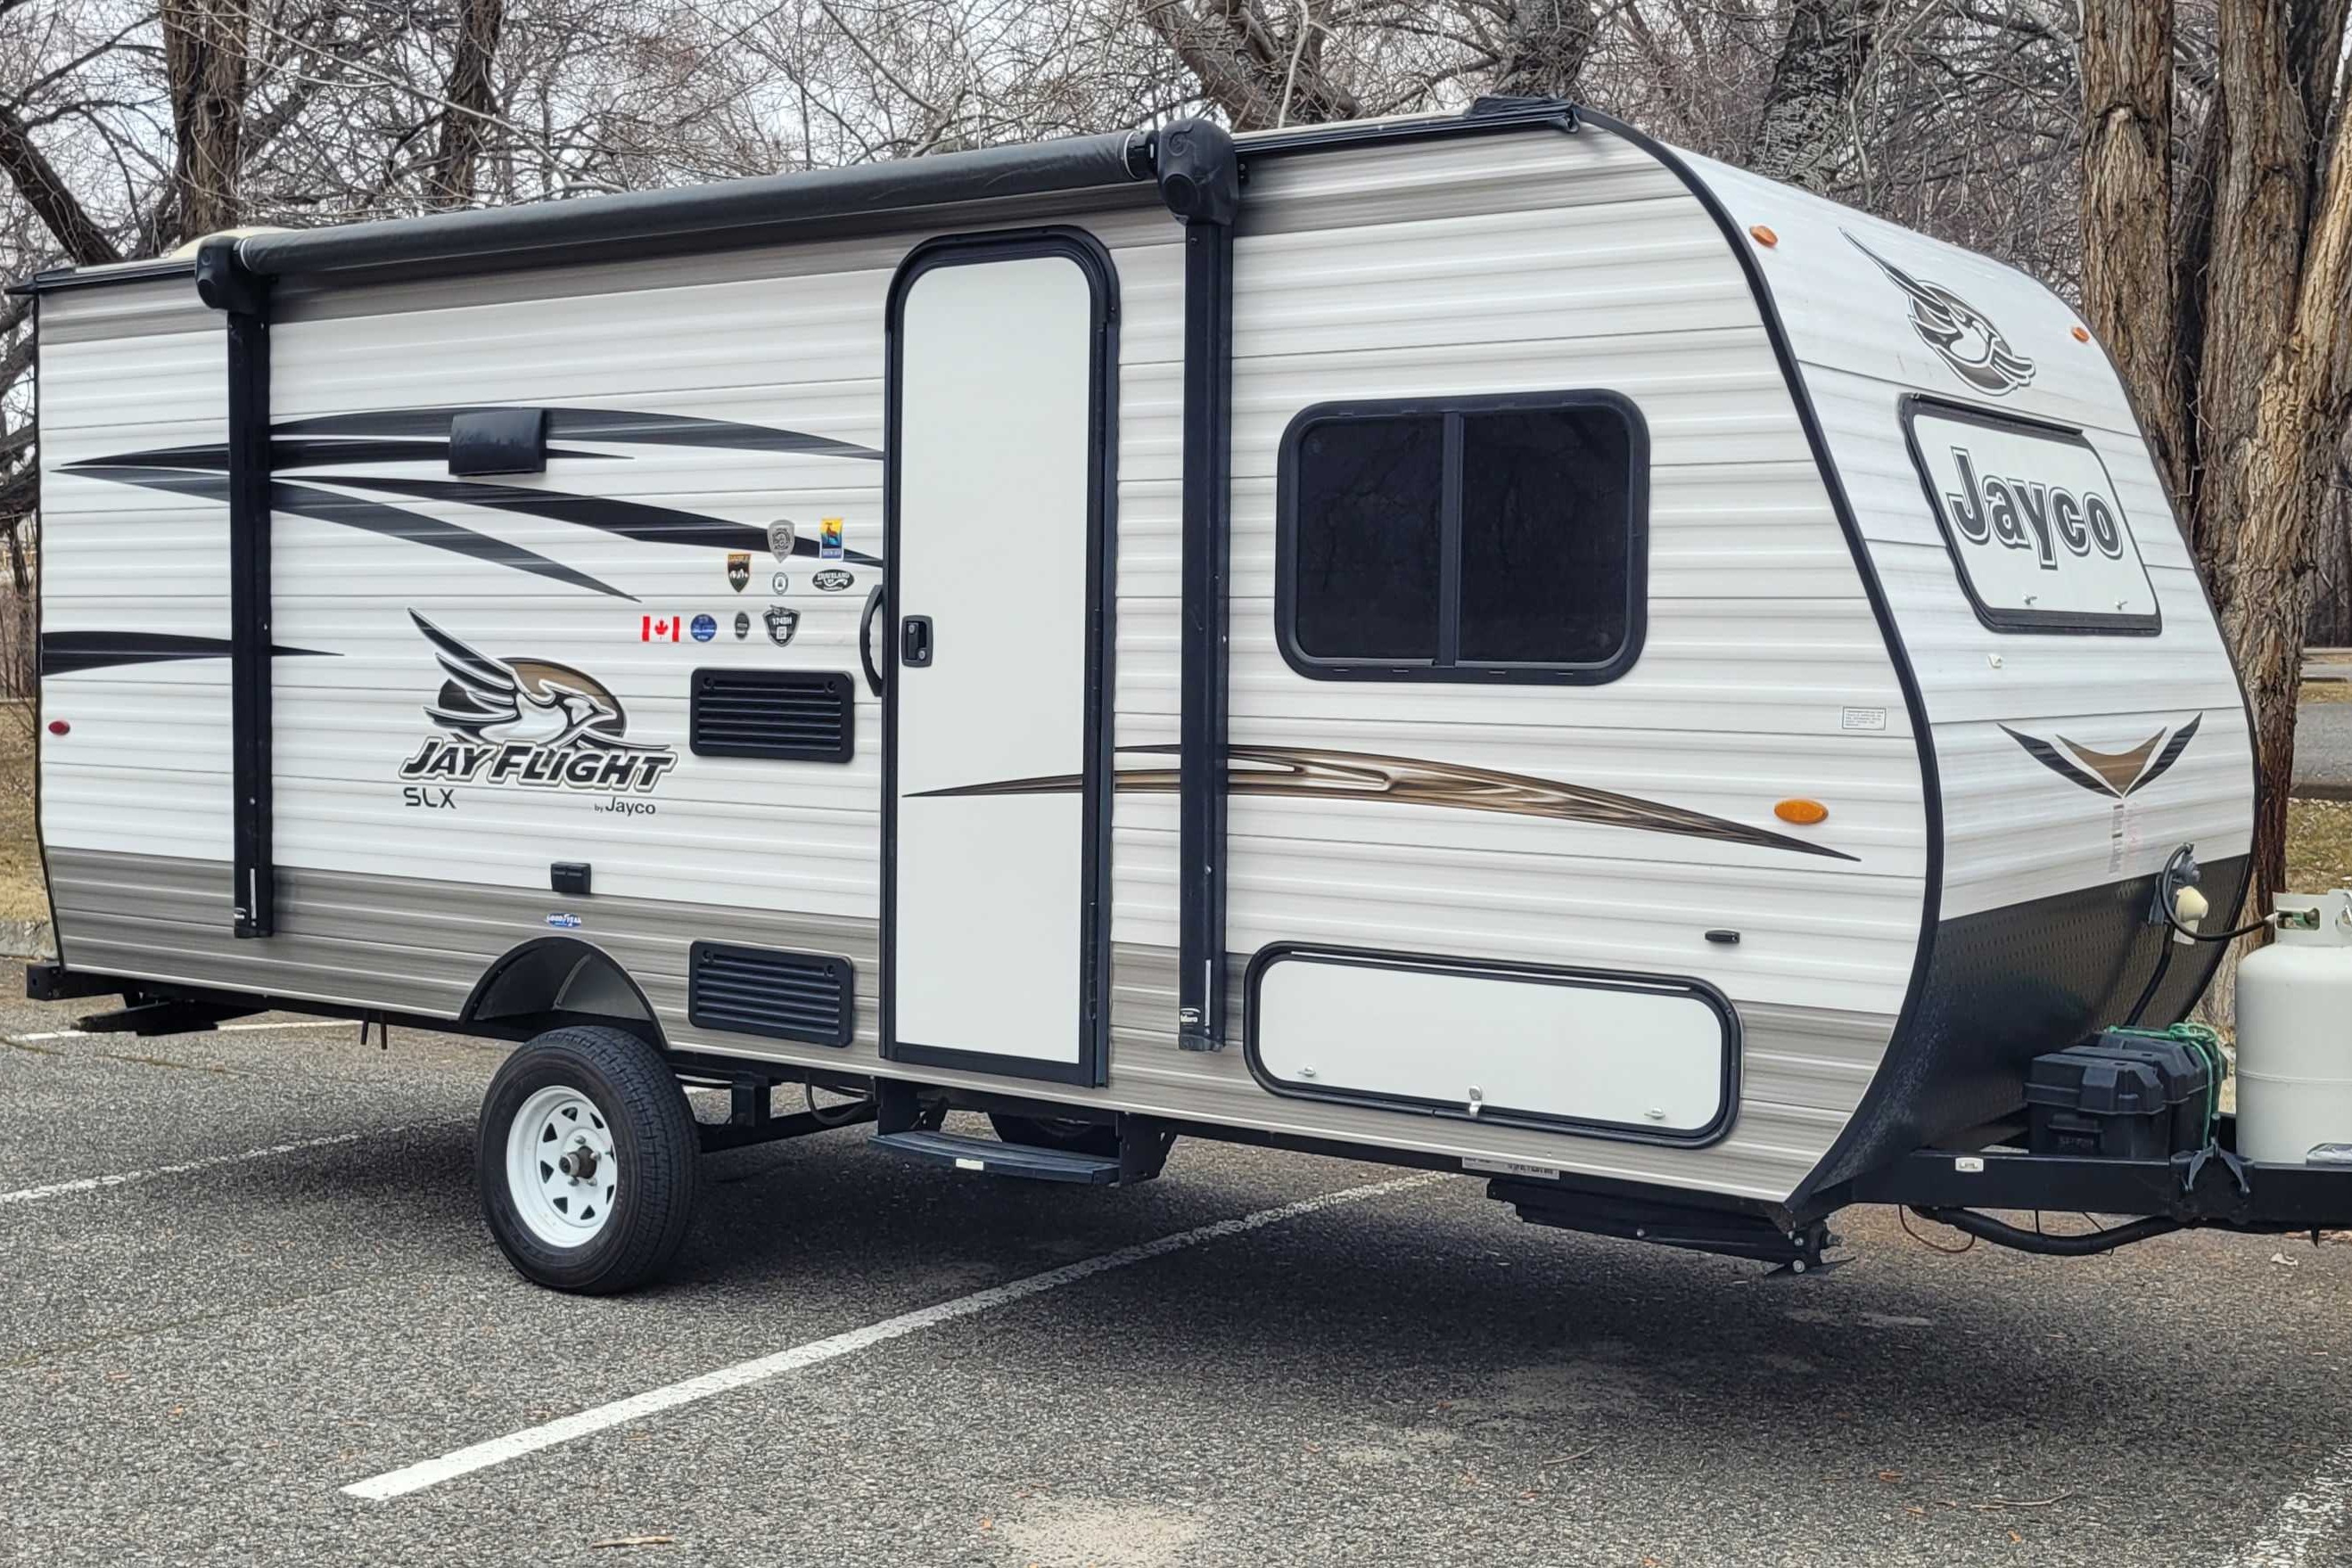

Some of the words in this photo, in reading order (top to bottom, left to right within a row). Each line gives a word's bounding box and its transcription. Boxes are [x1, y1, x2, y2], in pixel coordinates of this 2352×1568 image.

[1946, 446, 2124, 571] Jayco
[402, 739, 490, 777] JAY
[489, 742, 675, 788] FLIGHT
[404, 787, 456, 809] SLX
[605, 797, 656, 817] Jayco
